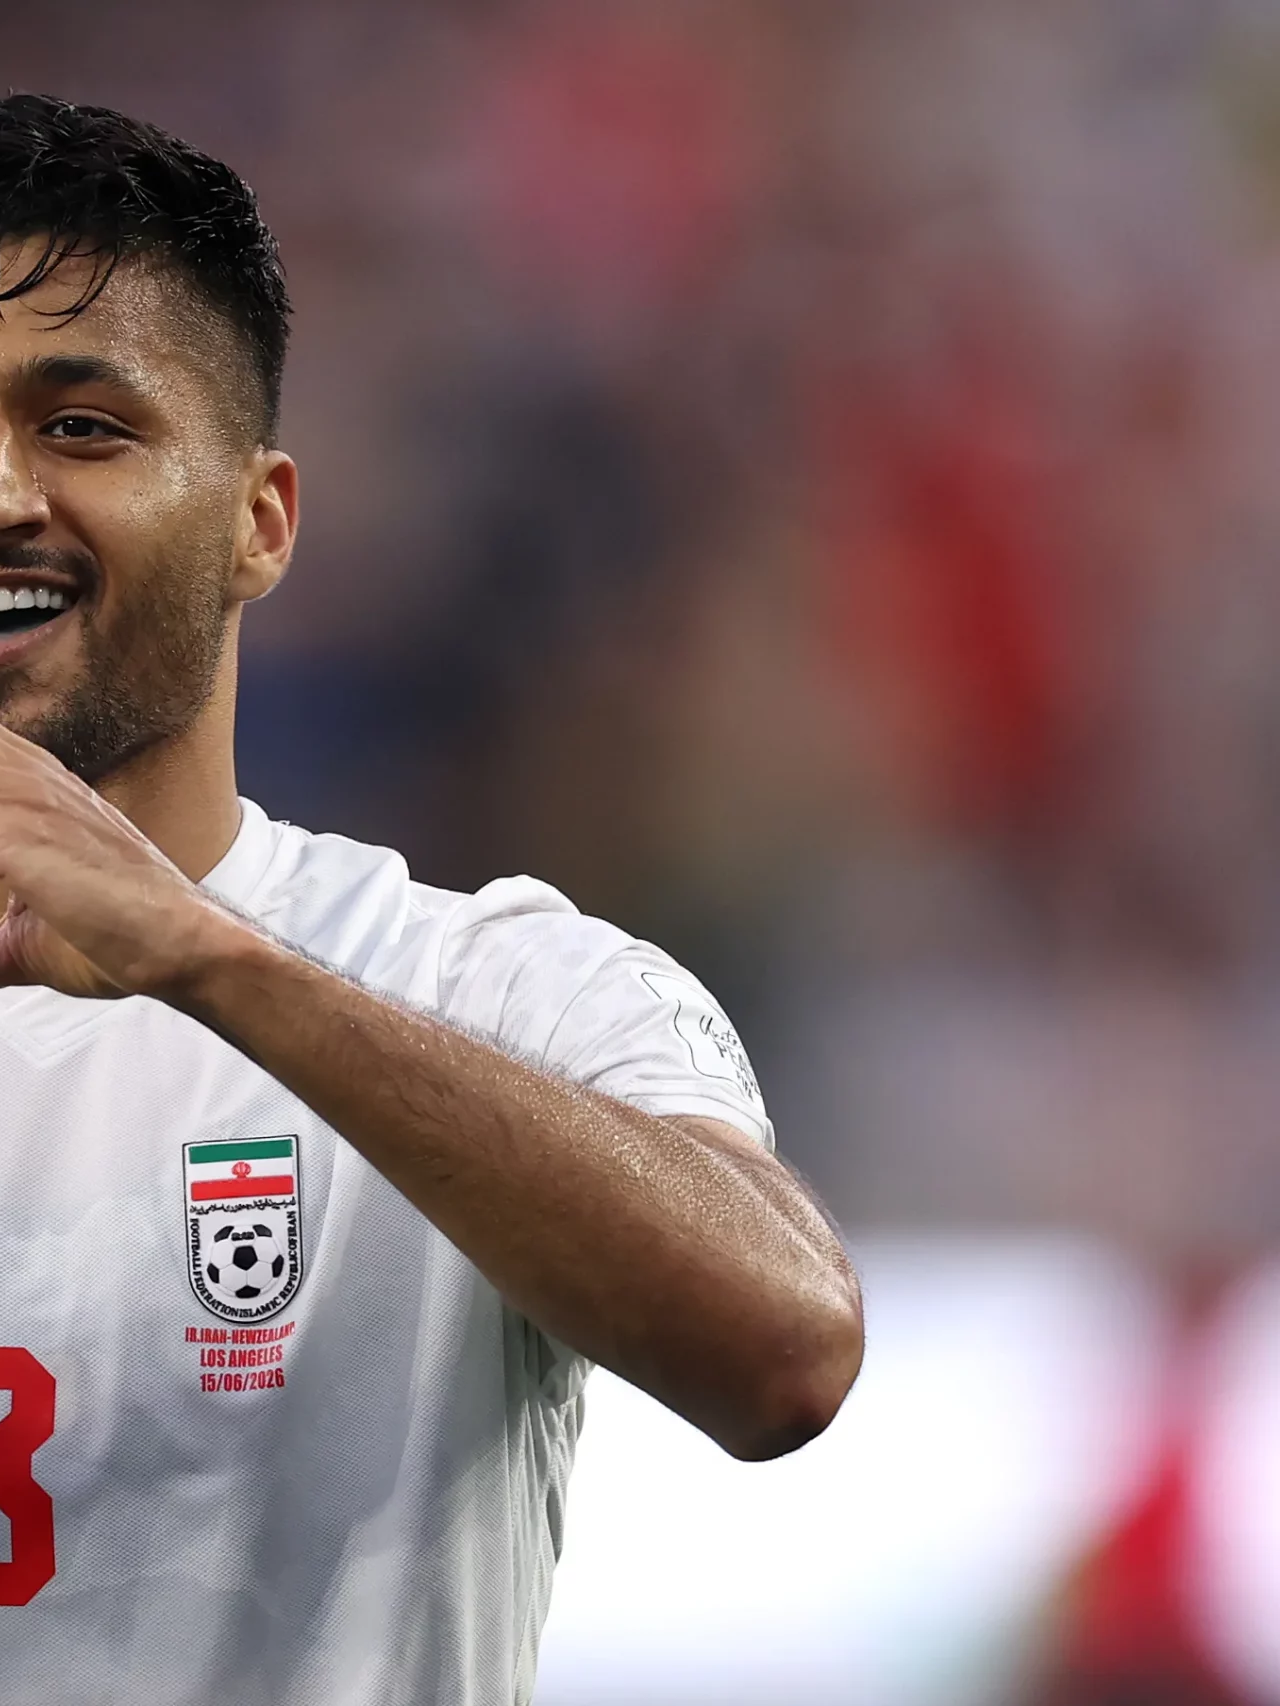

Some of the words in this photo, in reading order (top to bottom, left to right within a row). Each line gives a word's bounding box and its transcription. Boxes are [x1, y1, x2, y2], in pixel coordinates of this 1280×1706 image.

[190, 1218, 202, 1270] FOOTBALL
[193, 1271, 239, 1317] FEDERATION
[239, 1296, 281, 1317] ISLAMIC
[200, 1348, 227, 1368] LOS
[228, 1344, 283, 1368] ANGELES
[199, 1367, 285, 1392] 15/06/2026
